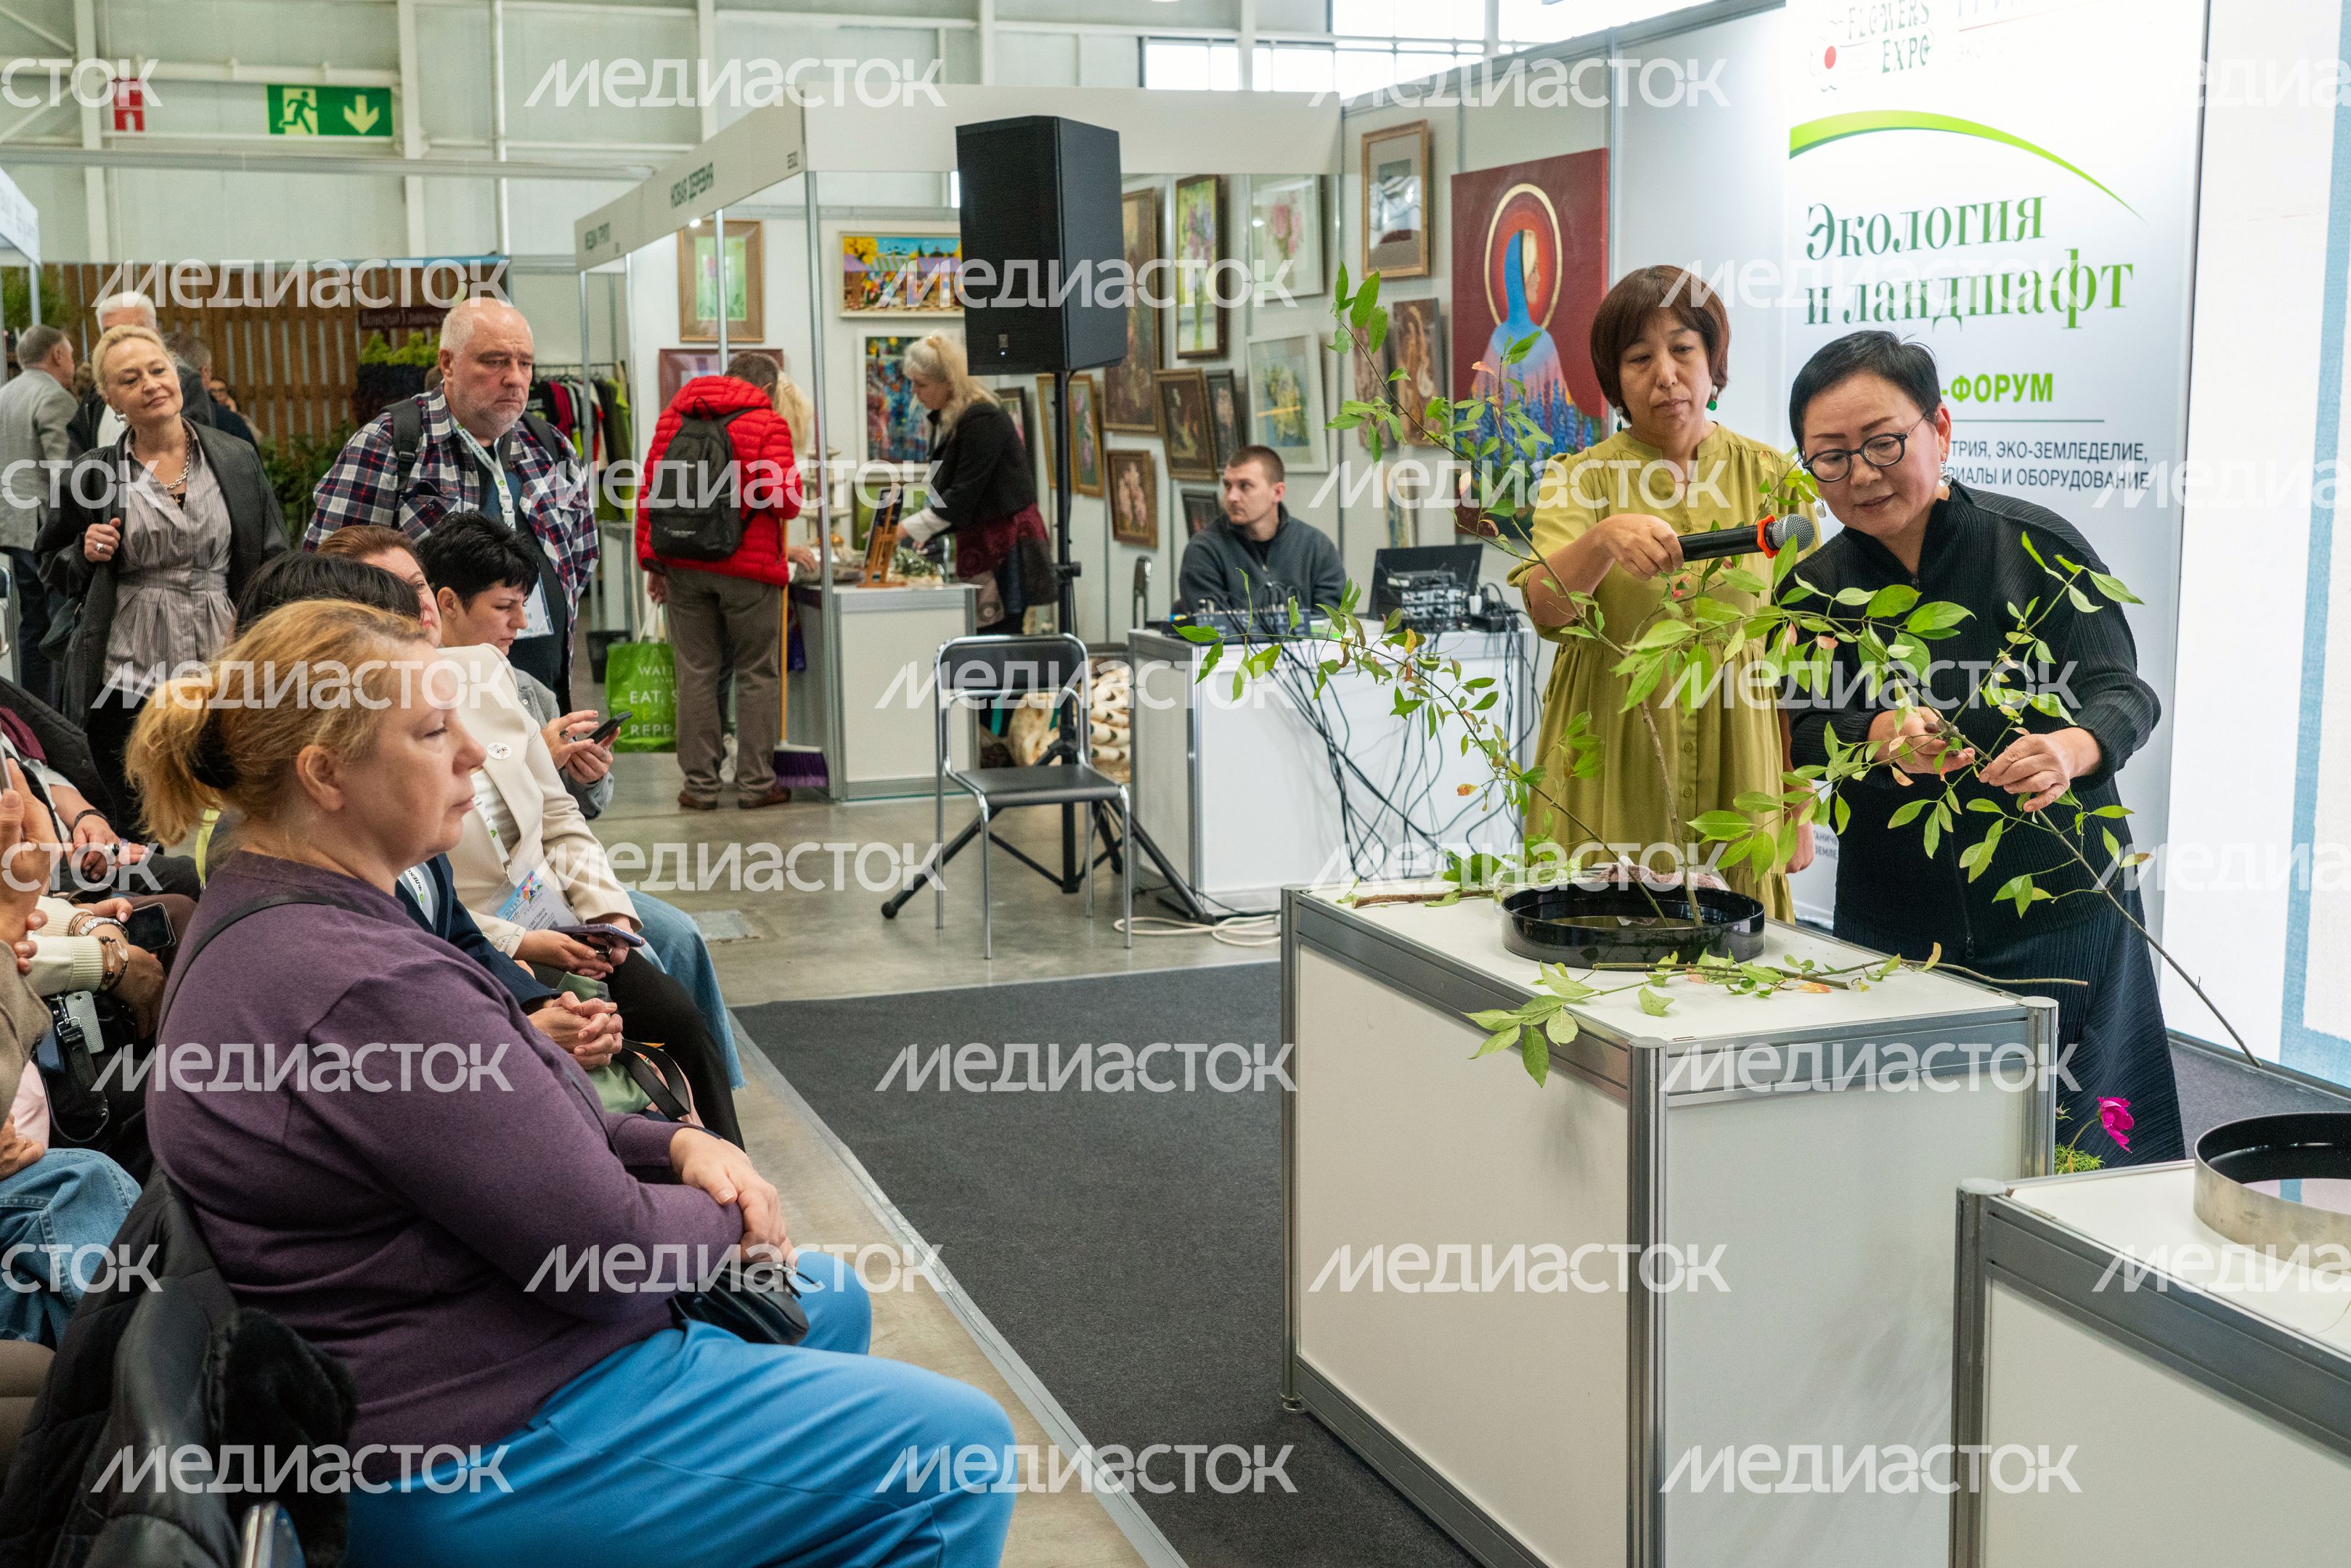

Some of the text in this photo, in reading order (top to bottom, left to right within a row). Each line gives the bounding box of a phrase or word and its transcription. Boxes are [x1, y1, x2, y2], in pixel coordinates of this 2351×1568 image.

[1881, 34, 1931, 74] EXPO
[1806, 195, 2046, 260] Экология
[1804, 248, 2134, 333] и ландшафт
[1996, 441, 2148, 463] ЭКО-ЗЕМЛЕДЕЛИЕ,
[2002, 469, 2011, 484] И
[2016, 469, 2150, 490] ОБОРУДОВАНИЕ
